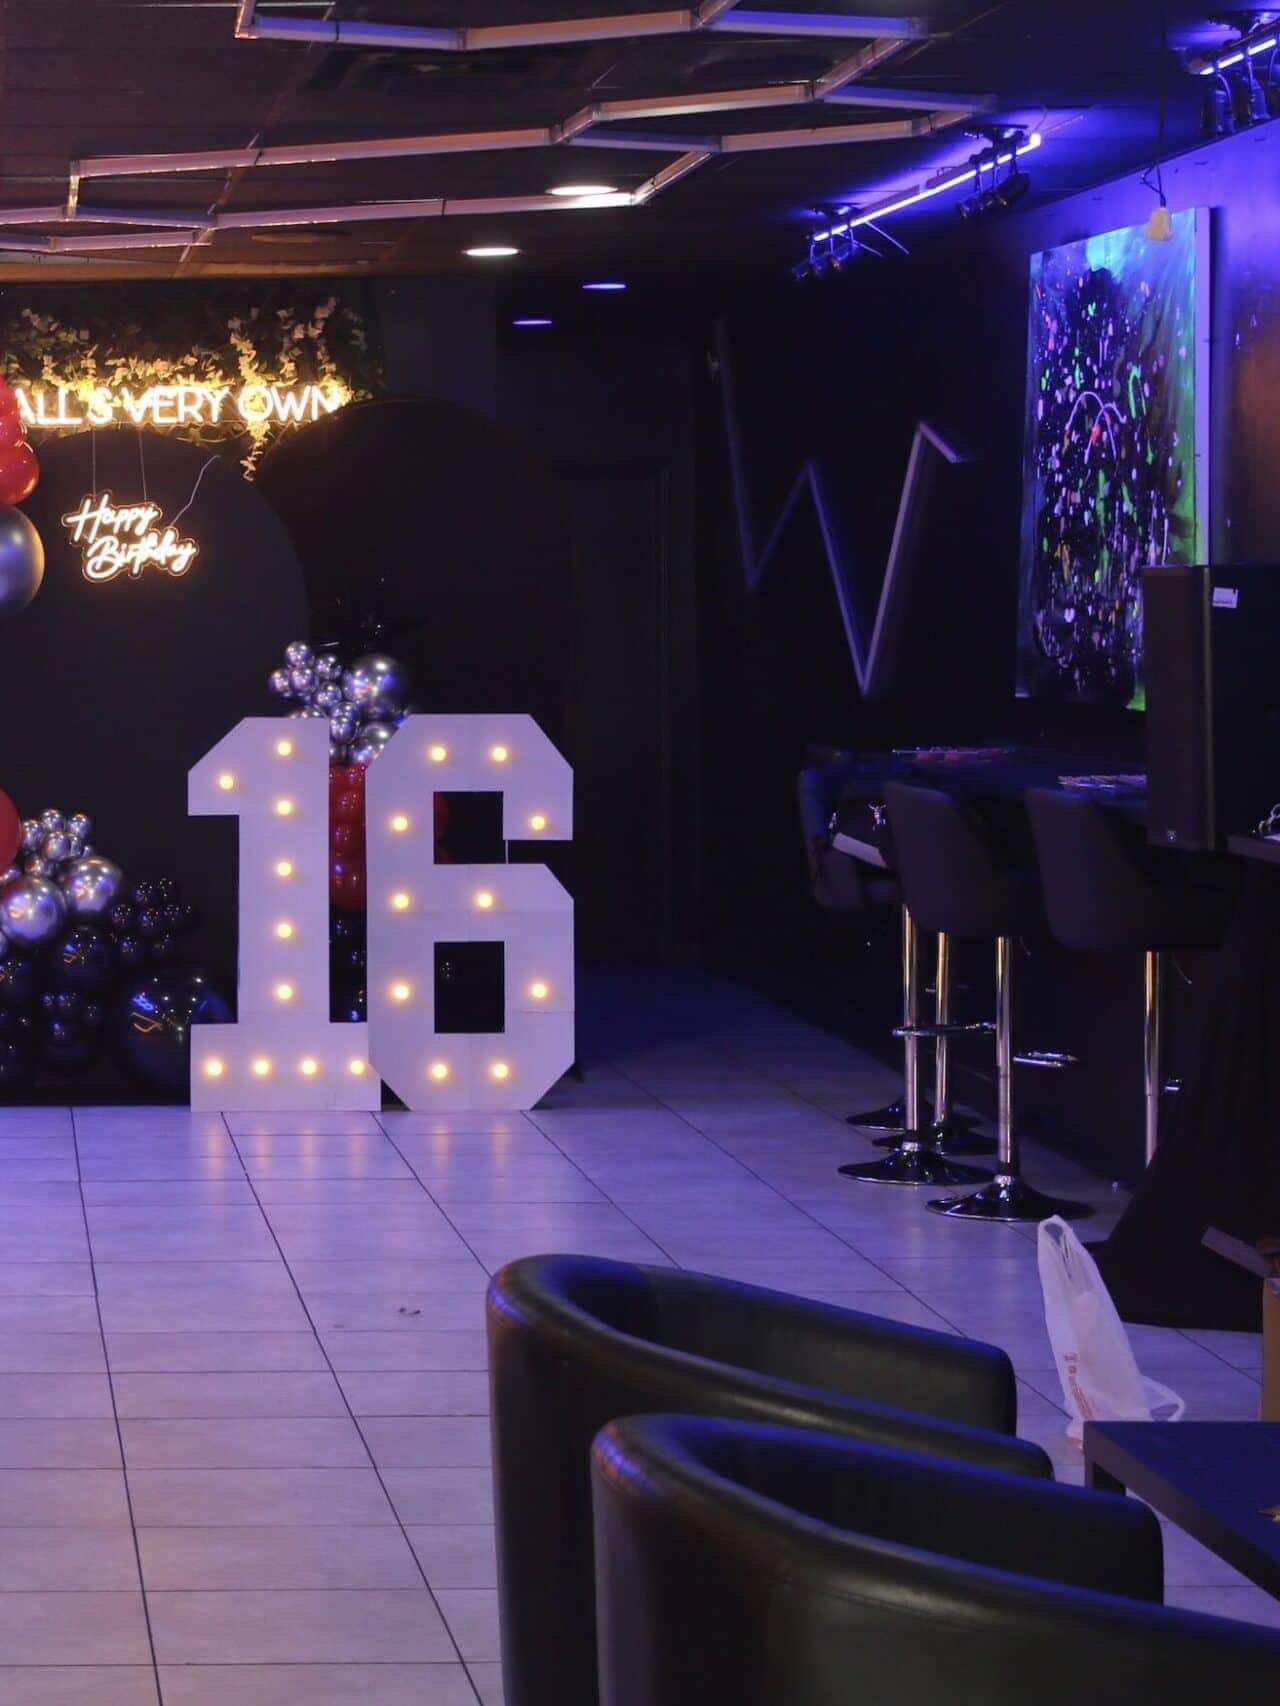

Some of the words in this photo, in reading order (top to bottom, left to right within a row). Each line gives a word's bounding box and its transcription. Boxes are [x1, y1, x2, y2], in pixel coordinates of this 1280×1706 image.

[121, 385, 230, 423] VERY
[238, 385, 342, 422] OWN
[66, 493, 159, 543] Happy
[86, 530, 197, 579] Birthday
[187, 713, 575, 1112] 16
